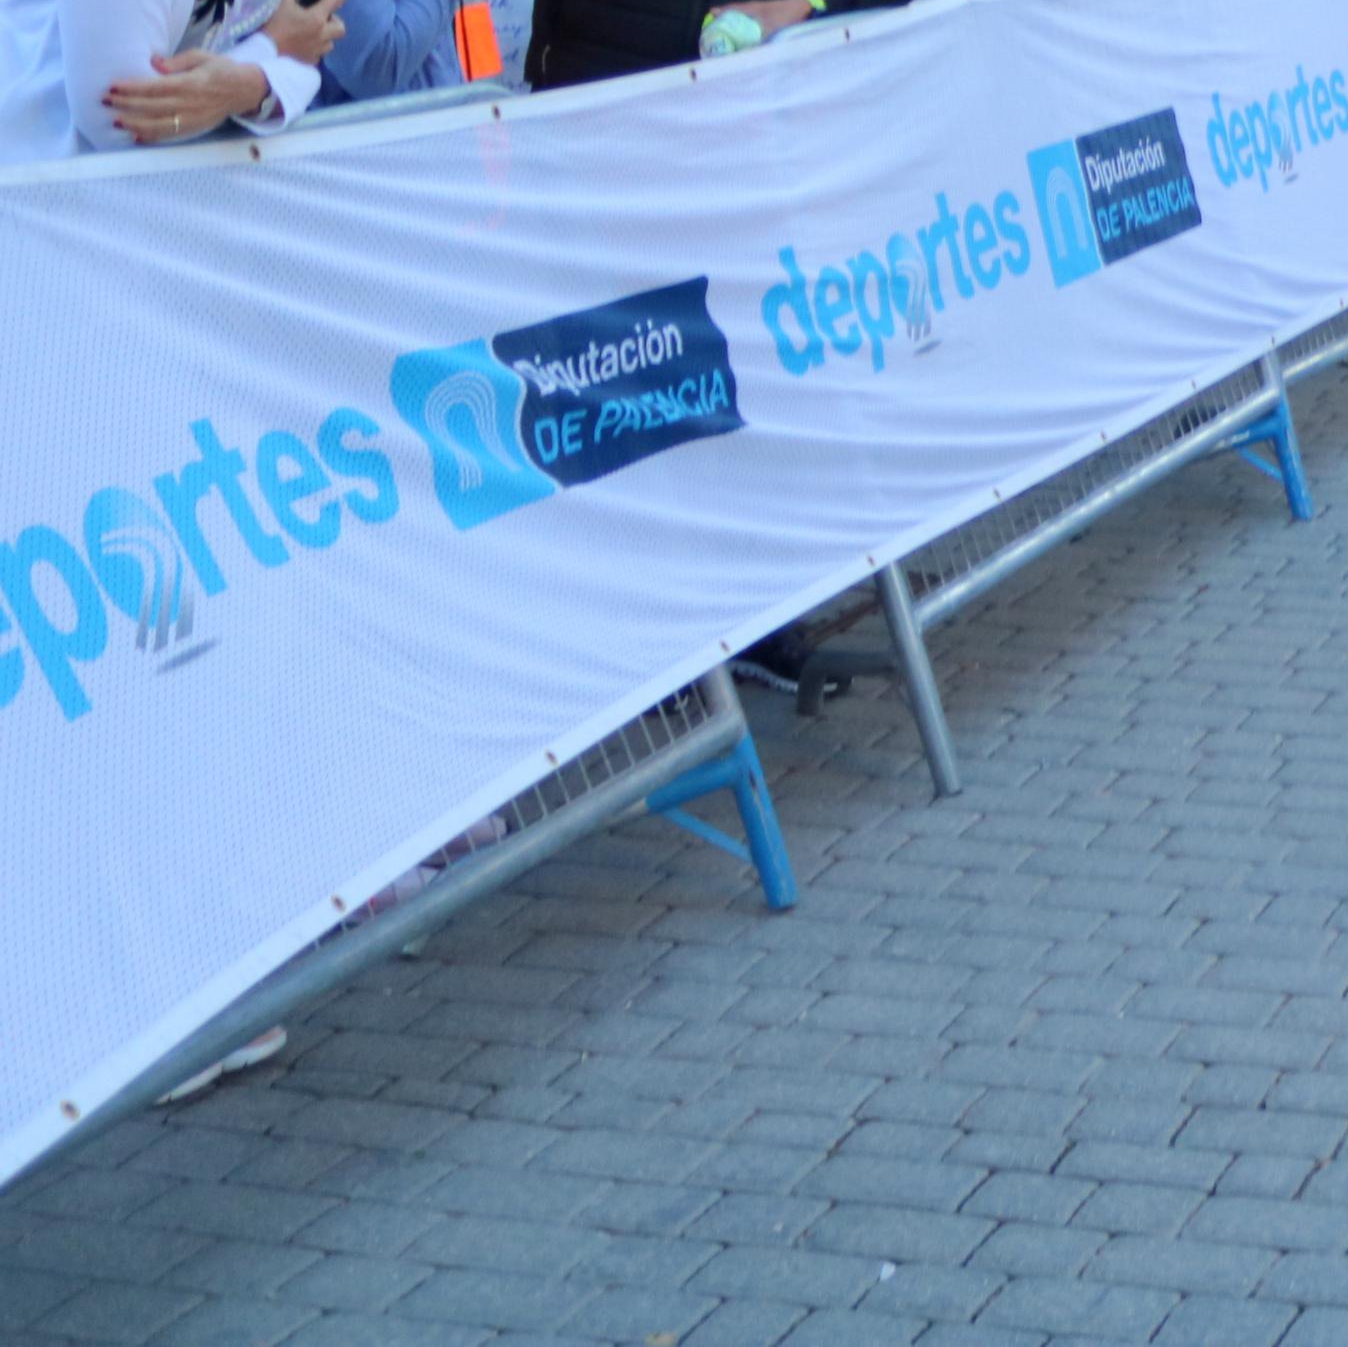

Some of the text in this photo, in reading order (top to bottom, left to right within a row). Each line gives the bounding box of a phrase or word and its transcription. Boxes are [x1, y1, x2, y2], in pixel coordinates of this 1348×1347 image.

[1084, 134, 1166, 195] Diputación
[1099, 175, 1195, 243] DE PALENCIA
[760, 190, 1032, 376] deportes
[533, 408, 588, 465] DE
